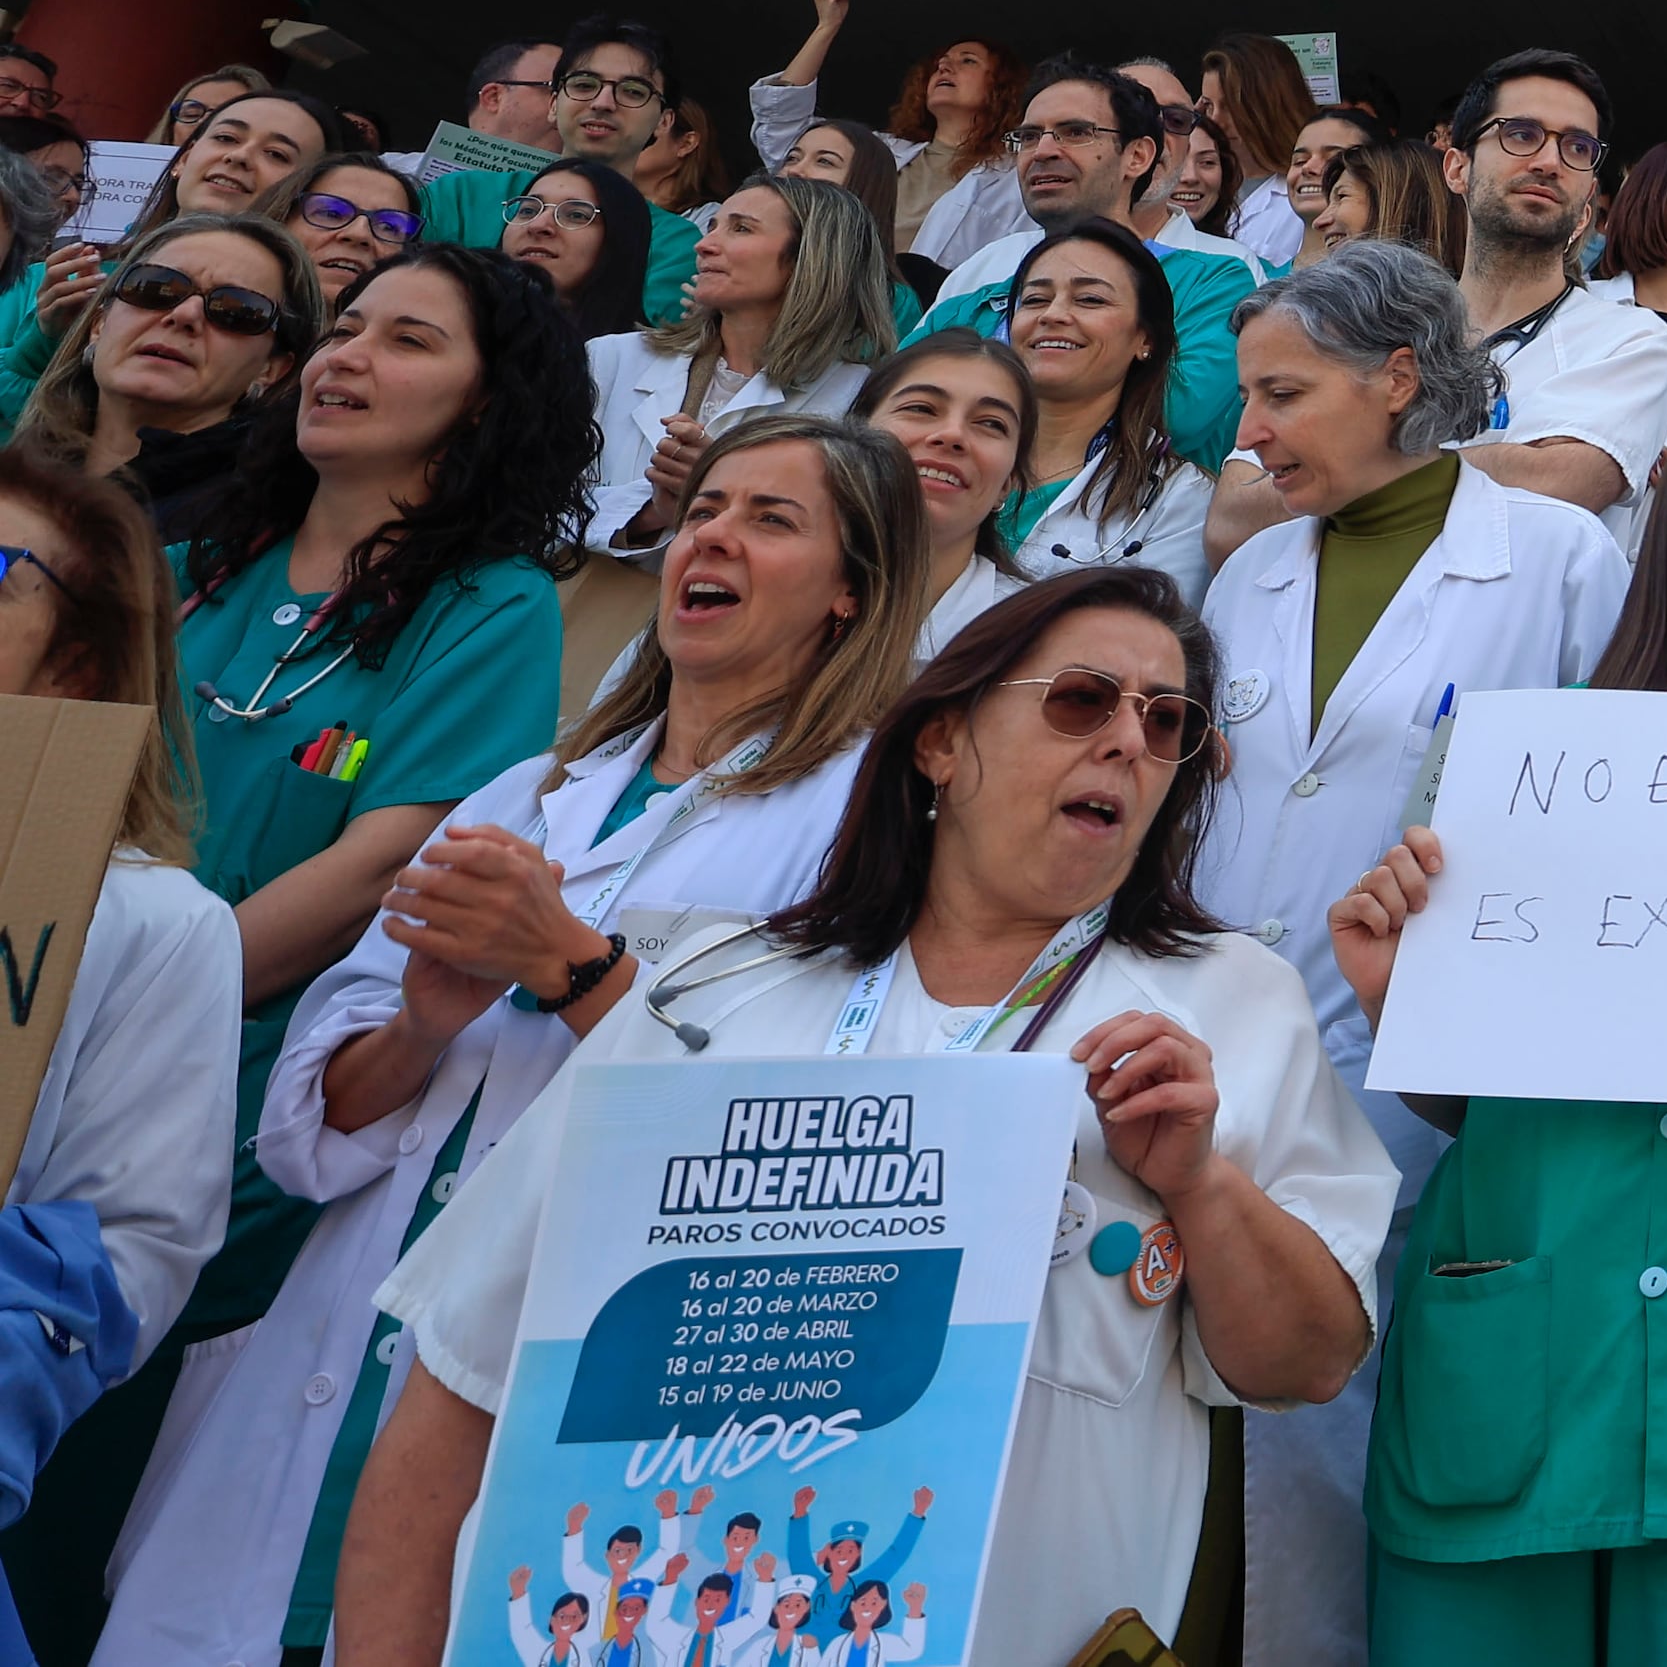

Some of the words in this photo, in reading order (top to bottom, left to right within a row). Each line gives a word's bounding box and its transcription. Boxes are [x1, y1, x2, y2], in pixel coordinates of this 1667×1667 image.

[439, 138, 452, 147] los
[455, 142, 491, 158] Médicos
[467, 135, 488, 147] ¿Por
[454, 152, 503, 173] Estatuto
[1510, 751, 1611, 816] NO
[1471, 892, 1545, 943] ES
[635, 937, 669, 951] SOY
[722, 1095, 912, 1154] HUELGA
[661, 1151, 943, 1214] INDEFINIDA
[647, 1222, 741, 1245] PAROS
[750, 1216, 946, 1242] CONVOCADOS
[688, 1270, 710, 1290] 16
[716, 1269, 735, 1289] al
[741, 1268, 771, 1288] 20
[775, 1266, 801, 1286] de
[805, 1264, 899, 1286] FEBRERO
[681, 1299, 703, 1318] 16
[708, 1297, 729, 1317] al
[732, 1296, 763, 1316] 20
[767, 1294, 793, 1314] de
[797, 1291, 878, 1314] MARZO
[673, 1326, 701, 1346] 27
[705, 1325, 725, 1345] al
[729, 1324, 759, 1343] 30
[762, 1322, 789, 1342] de
[795, 1319, 854, 1340] ABRIL
[666, 1356, 689, 1375] 18
[693, 1355, 714, 1374] al
[718, 1353, 748, 1373] 22
[752, 1351, 780, 1371] de
[784, 1349, 855, 1371] MAYO
[658, 1386, 680, 1405] 15
[684, 1384, 705, 1405] al
[712, 1383, 733, 1403] 19
[738, 1381, 765, 1401] de
[769, 1379, 842, 1401] JUNIO
[625, 1408, 863, 1489] UNIDOS
